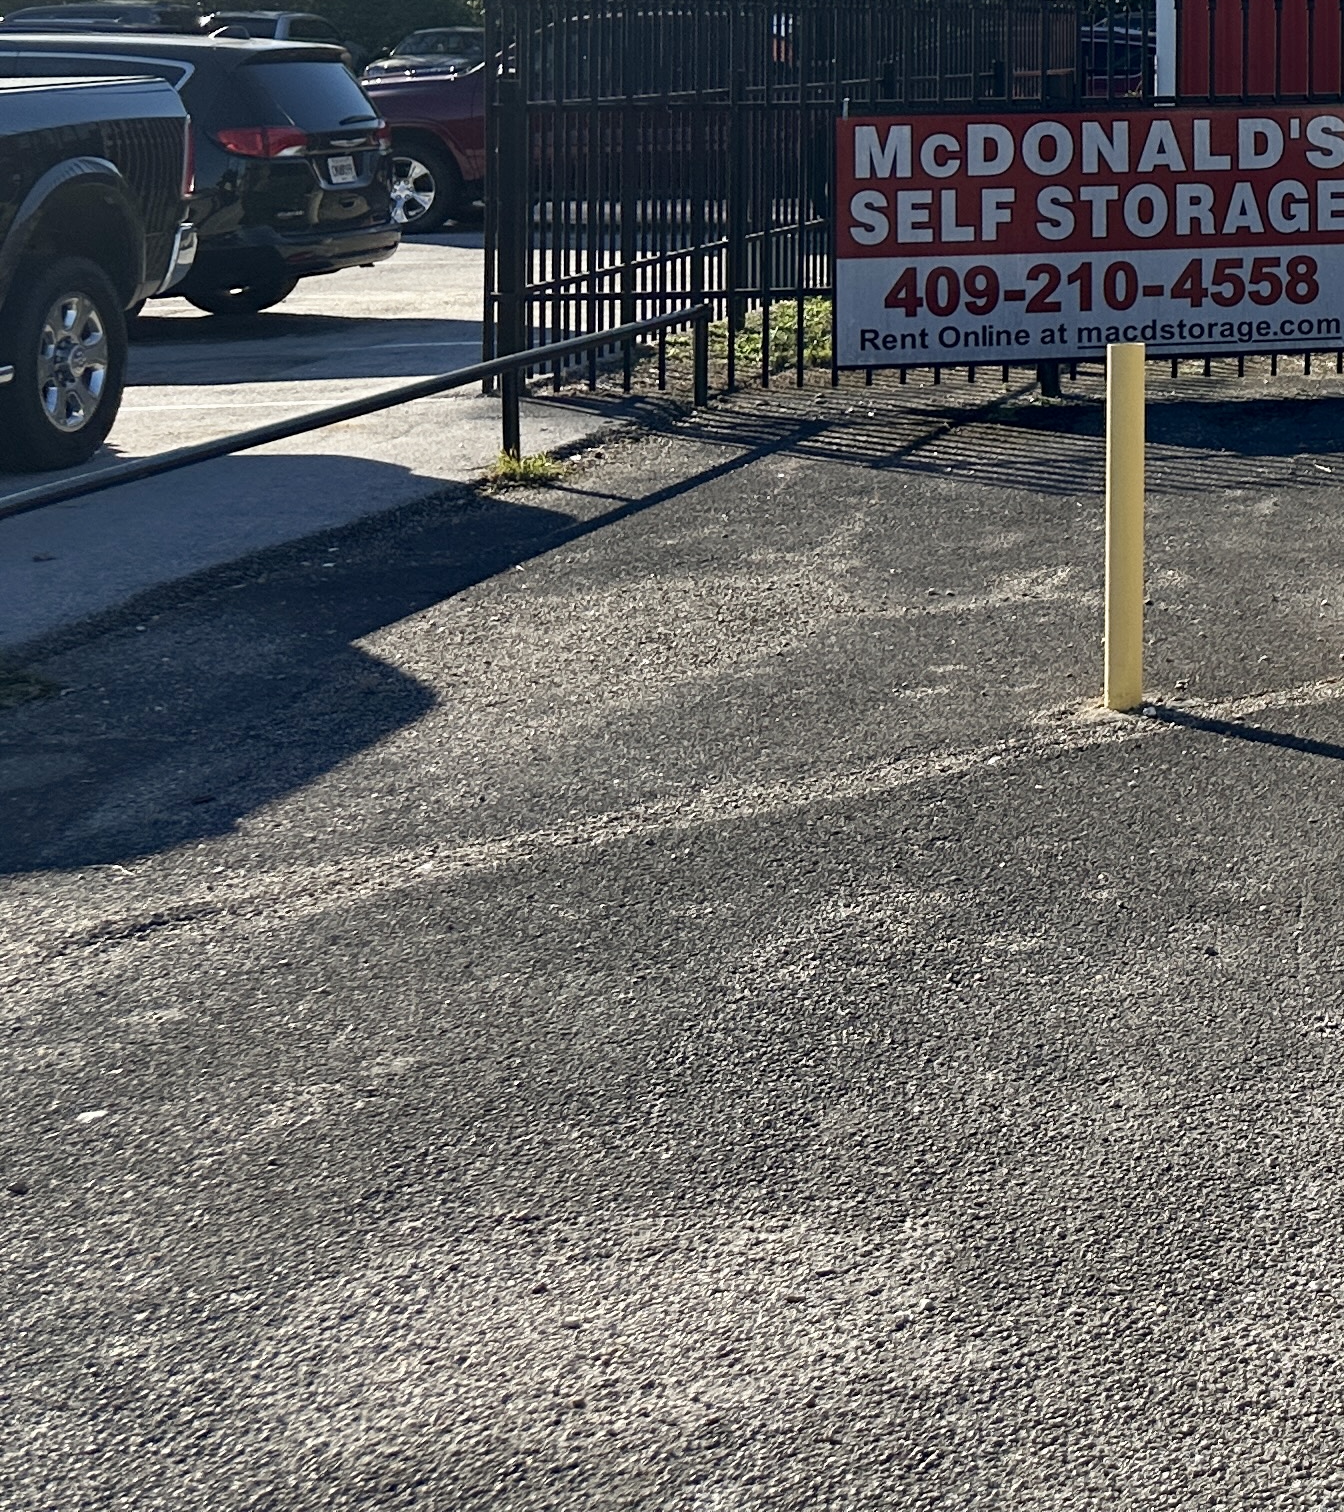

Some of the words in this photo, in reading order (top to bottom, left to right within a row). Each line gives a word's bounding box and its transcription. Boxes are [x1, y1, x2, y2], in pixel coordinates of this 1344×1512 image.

[849, 186, 1016, 246] SELF
[883, 254, 1321, 318] 409-210-4558
[860, 327, 929, 351] Rent
[938, 324, 1031, 348] Online
[1040, 325, 1069, 345] at
[1077, 315, 1342, 346] macdstorage.com
